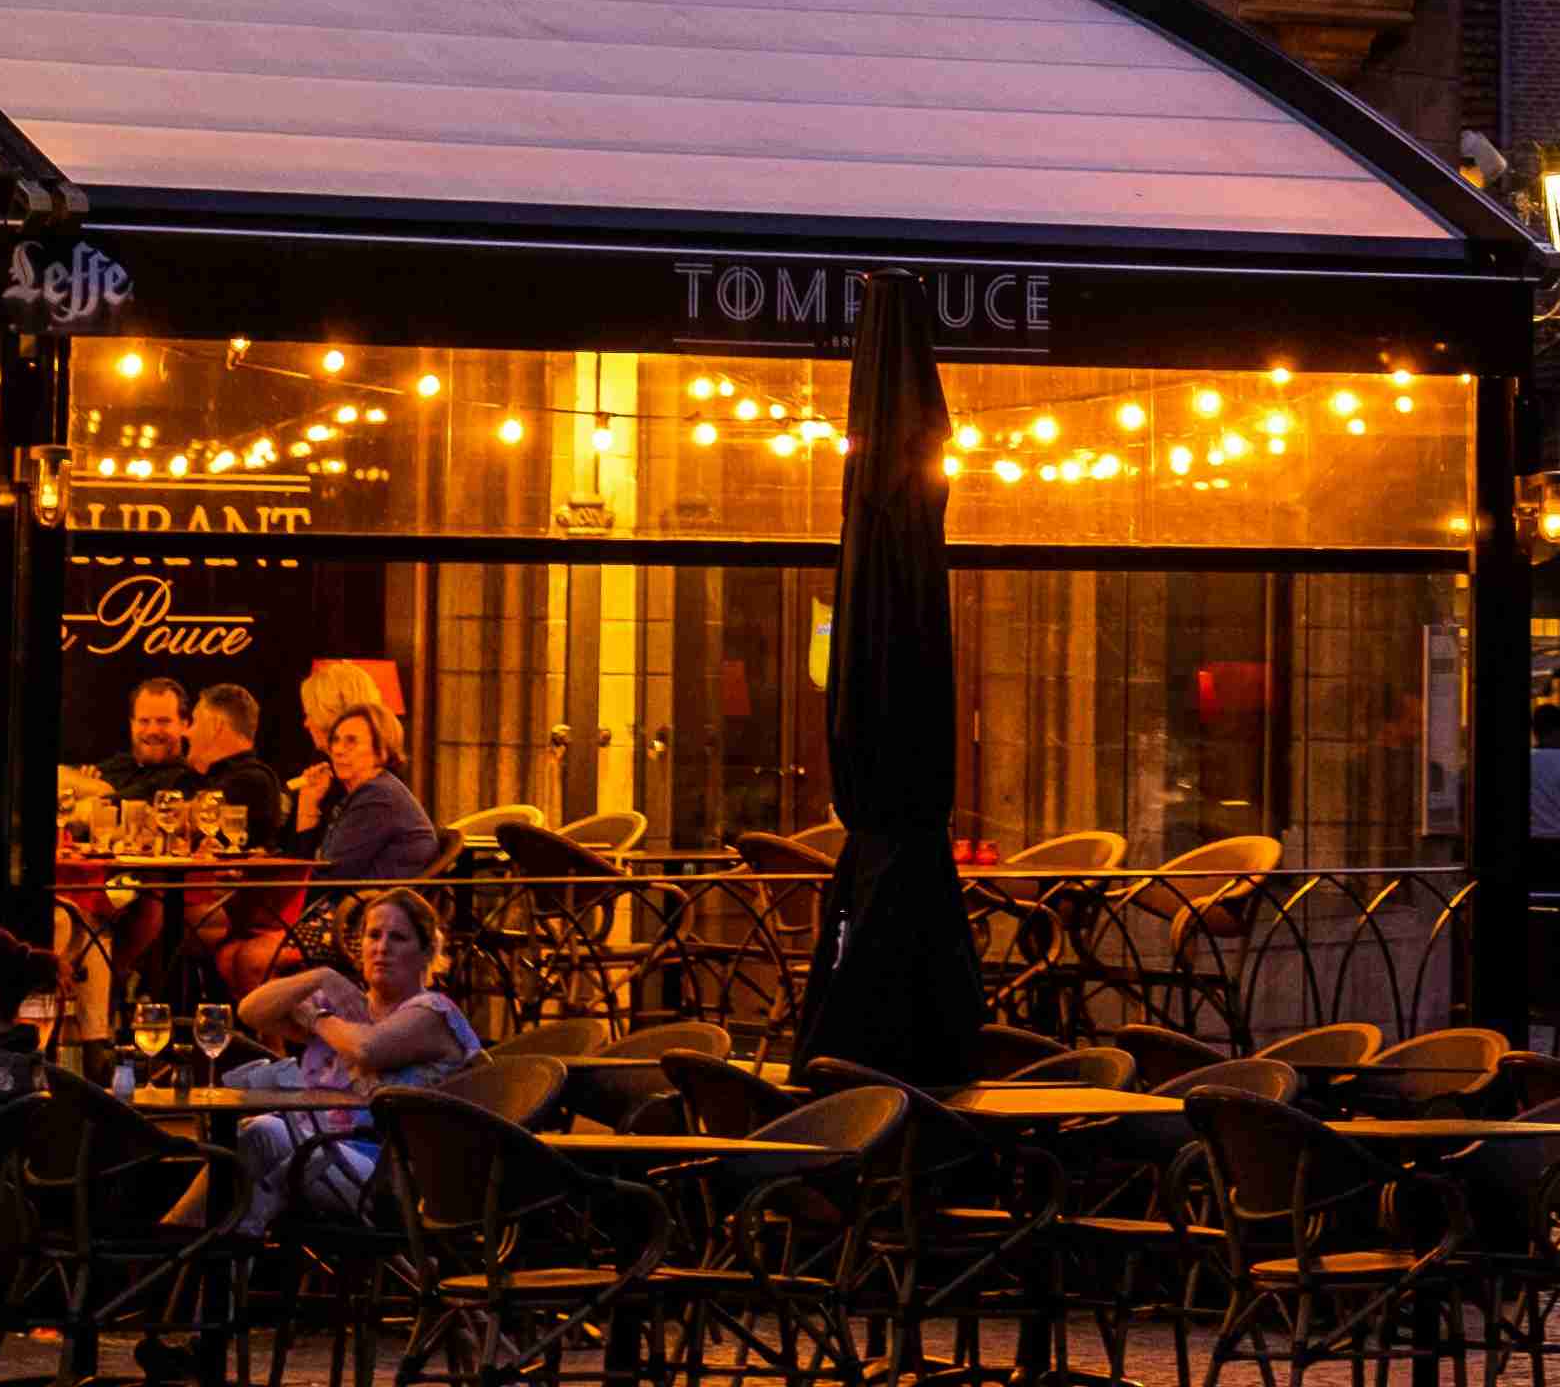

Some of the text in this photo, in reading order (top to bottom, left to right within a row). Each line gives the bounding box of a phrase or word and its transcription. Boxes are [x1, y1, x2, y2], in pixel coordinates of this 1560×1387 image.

[2, 240, 134, 323] Leffe
[673, 262, 1052, 330] TOMPUCE
[87, 574, 253, 656] Pouce
